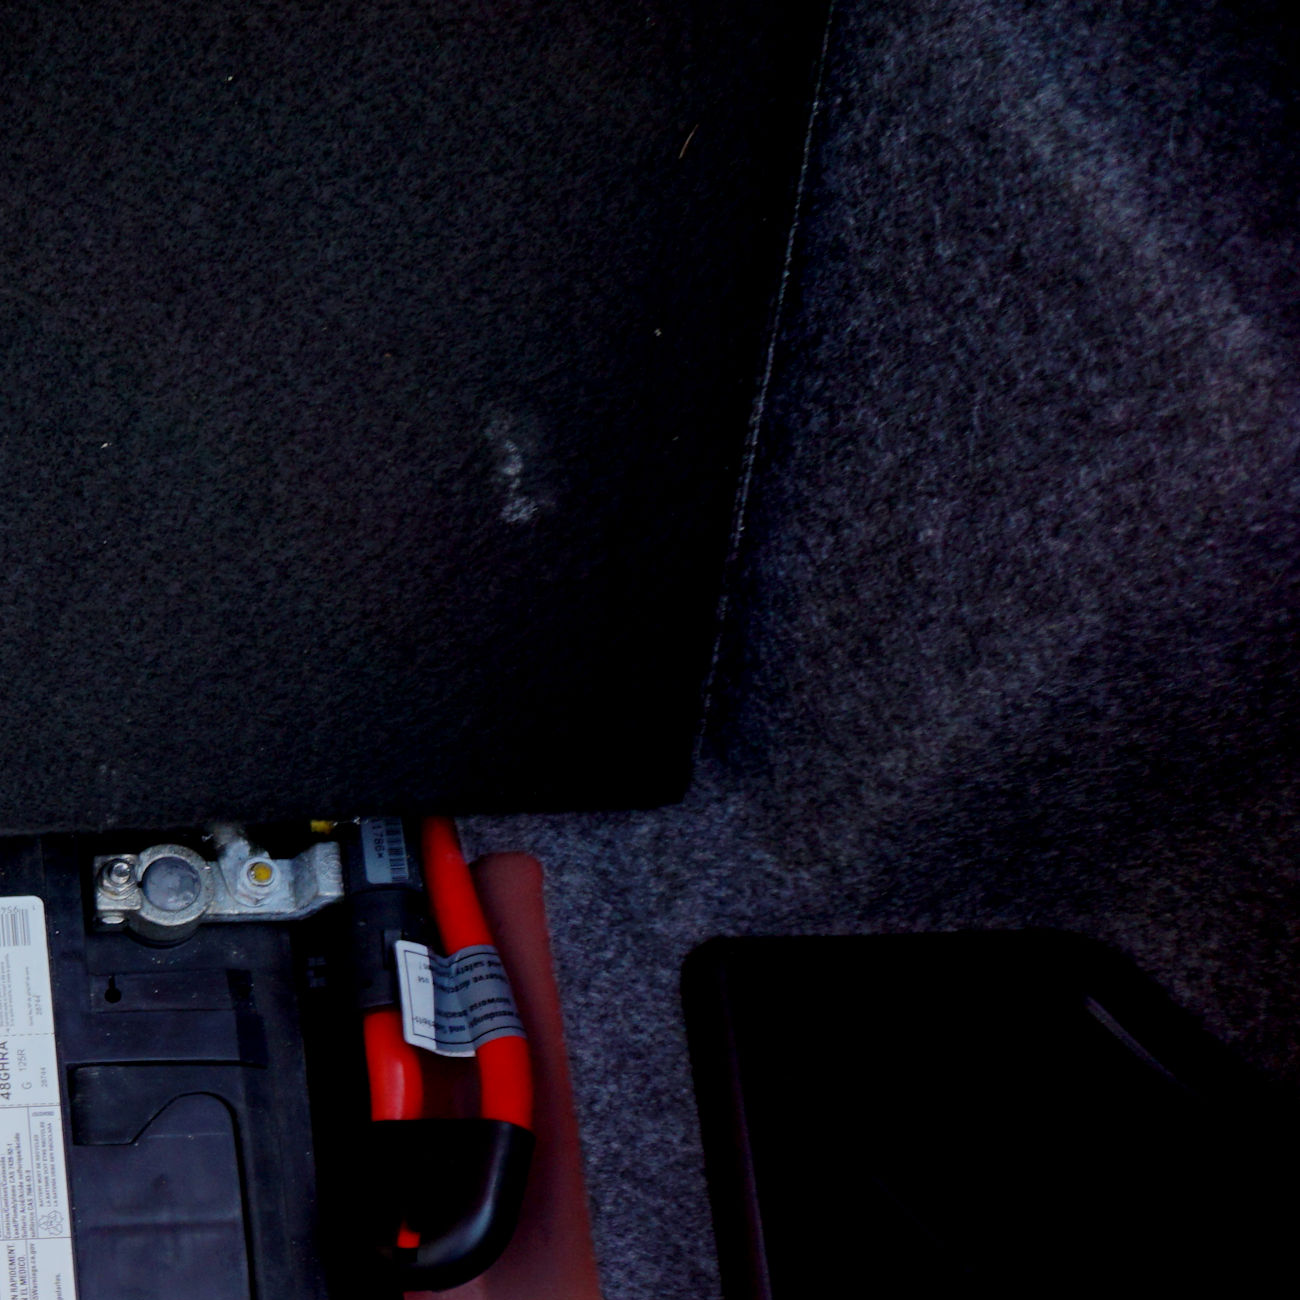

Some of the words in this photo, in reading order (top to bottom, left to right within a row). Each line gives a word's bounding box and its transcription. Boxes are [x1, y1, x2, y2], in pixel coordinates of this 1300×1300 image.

[16, 1048, 27, 1072] 125R
[21, 1081, 33, 1090] G
[20, 1288, 28, 1296] EL
